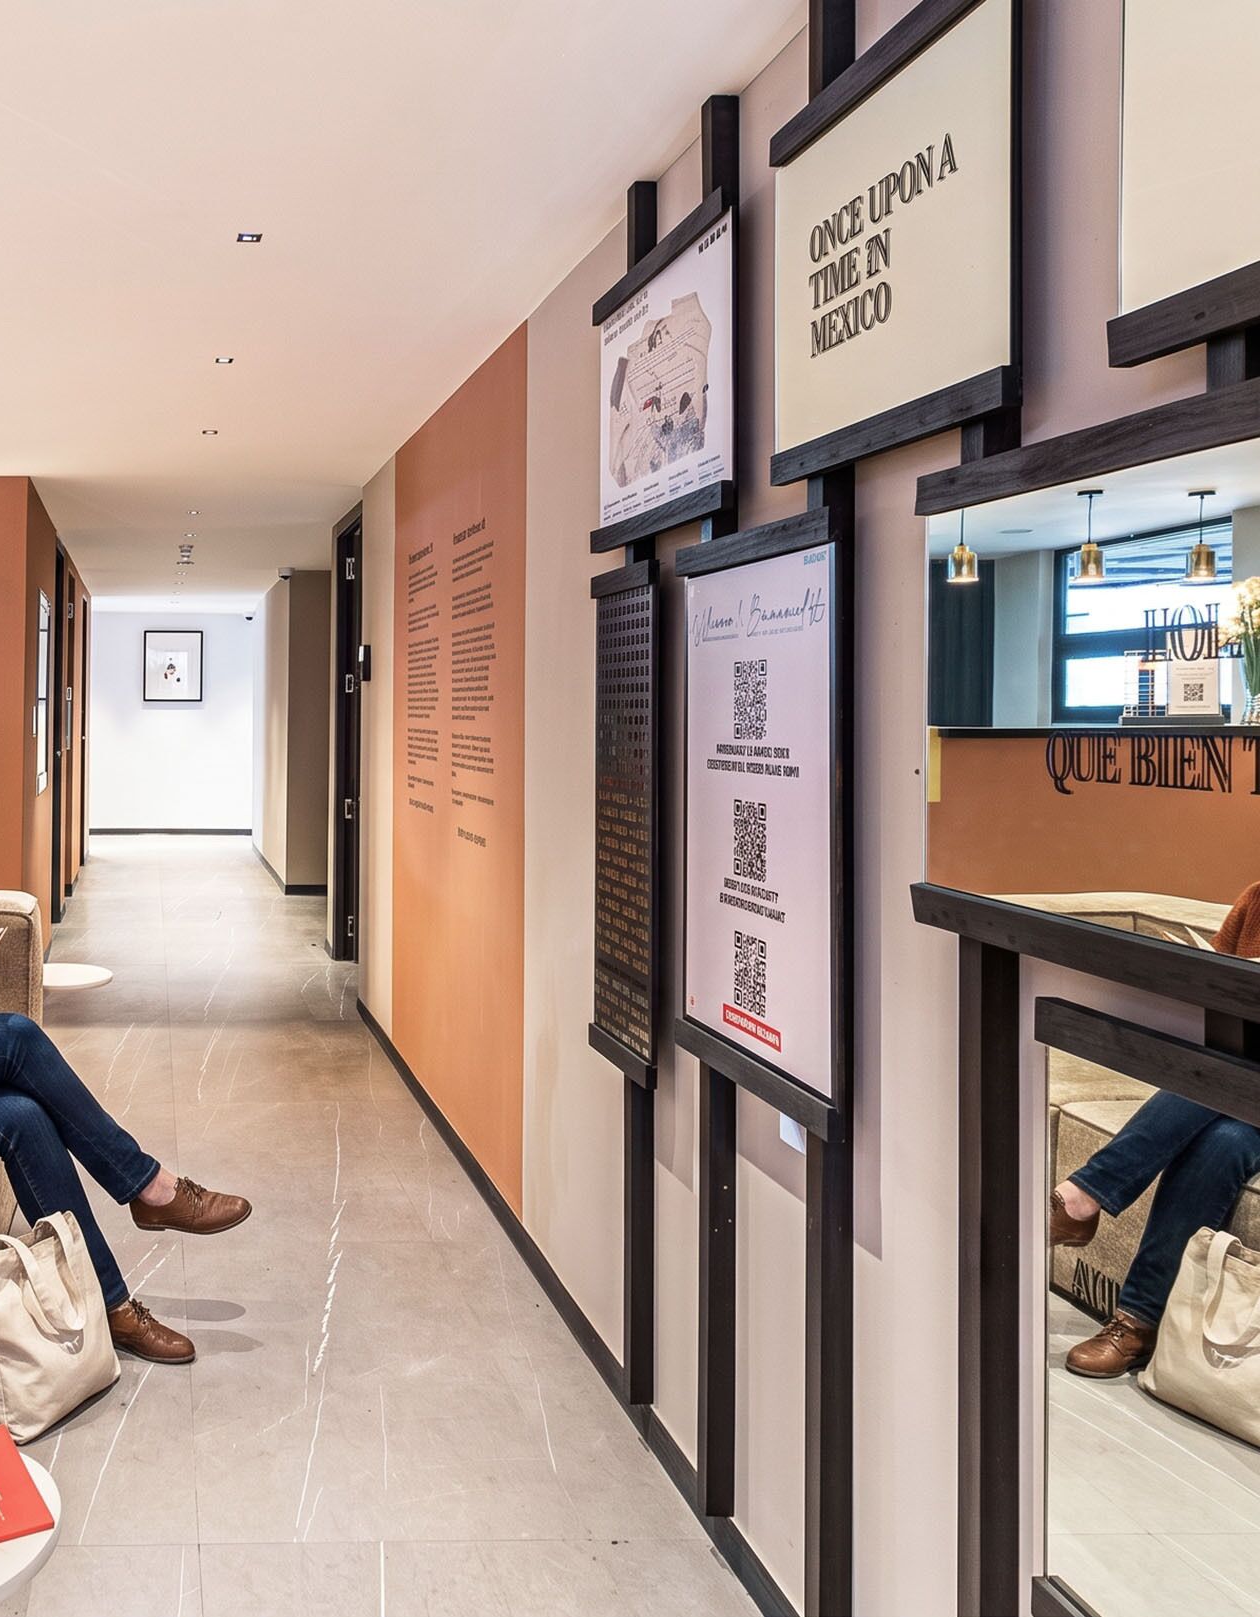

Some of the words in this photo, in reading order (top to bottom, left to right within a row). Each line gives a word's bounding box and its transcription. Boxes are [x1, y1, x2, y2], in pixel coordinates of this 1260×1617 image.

[809, 195, 864, 264] ONCE
[868, 144, 935, 224] UPON
[936, 133, 959, 181] A
[809, 247, 860, 310] TIME
[865, 227, 892, 279] IN
[810, 281, 892, 359] MEXICO
[1129, 733, 1233, 793] BIEN
